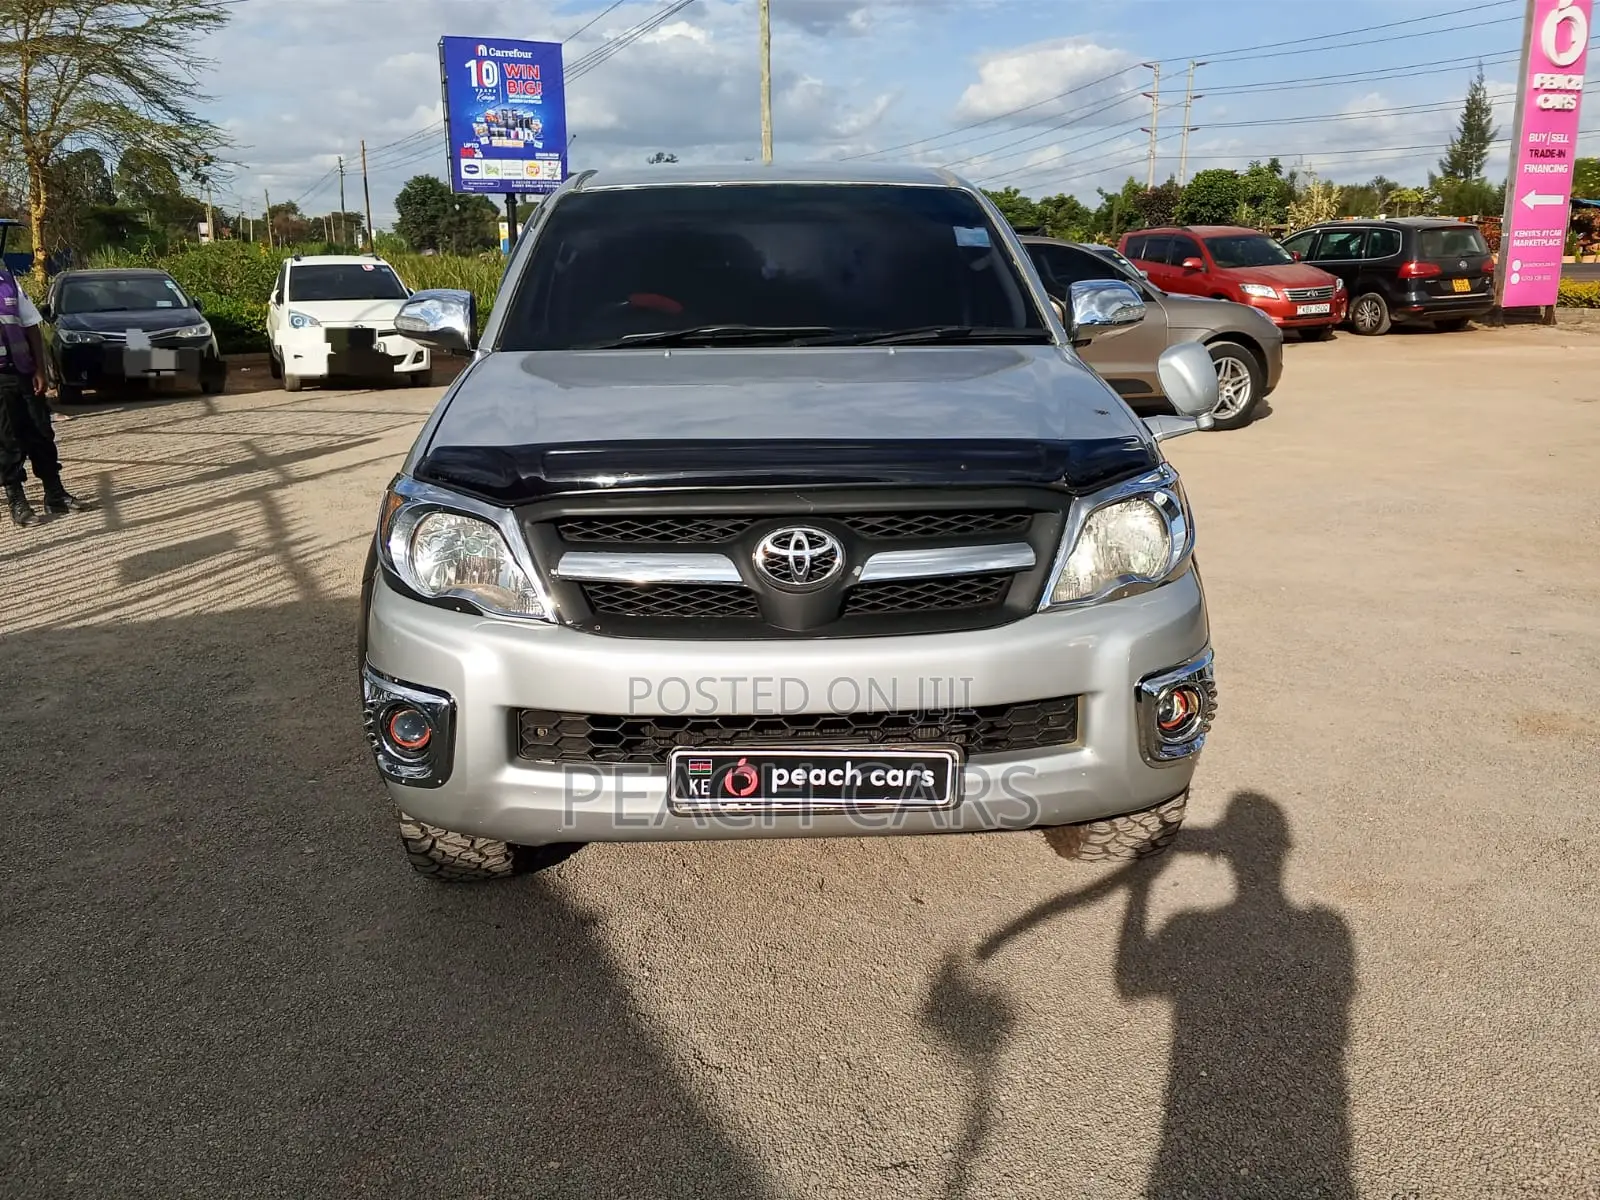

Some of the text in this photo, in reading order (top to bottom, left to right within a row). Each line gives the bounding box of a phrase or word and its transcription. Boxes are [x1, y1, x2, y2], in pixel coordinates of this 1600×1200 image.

[489, 47, 533, 59] Carrefour
[464, 59, 498, 88] 10
[503, 63, 540, 80] WIN
[507, 80, 542, 95] BIG!
[1528, 133, 1570, 143] BUY SELL
[1529, 149, 1566, 158] TRADE-IN
[1523, 164, 1569, 174] FINANCING
[1514, 229, 1541, 238] KENYA'S
[1549, 229, 1563, 237] CAR
[1513, 238, 1561, 247] MARKETPLACE
[771, 761, 936, 793] peach cars
[688, 778, 711, 796] KE
